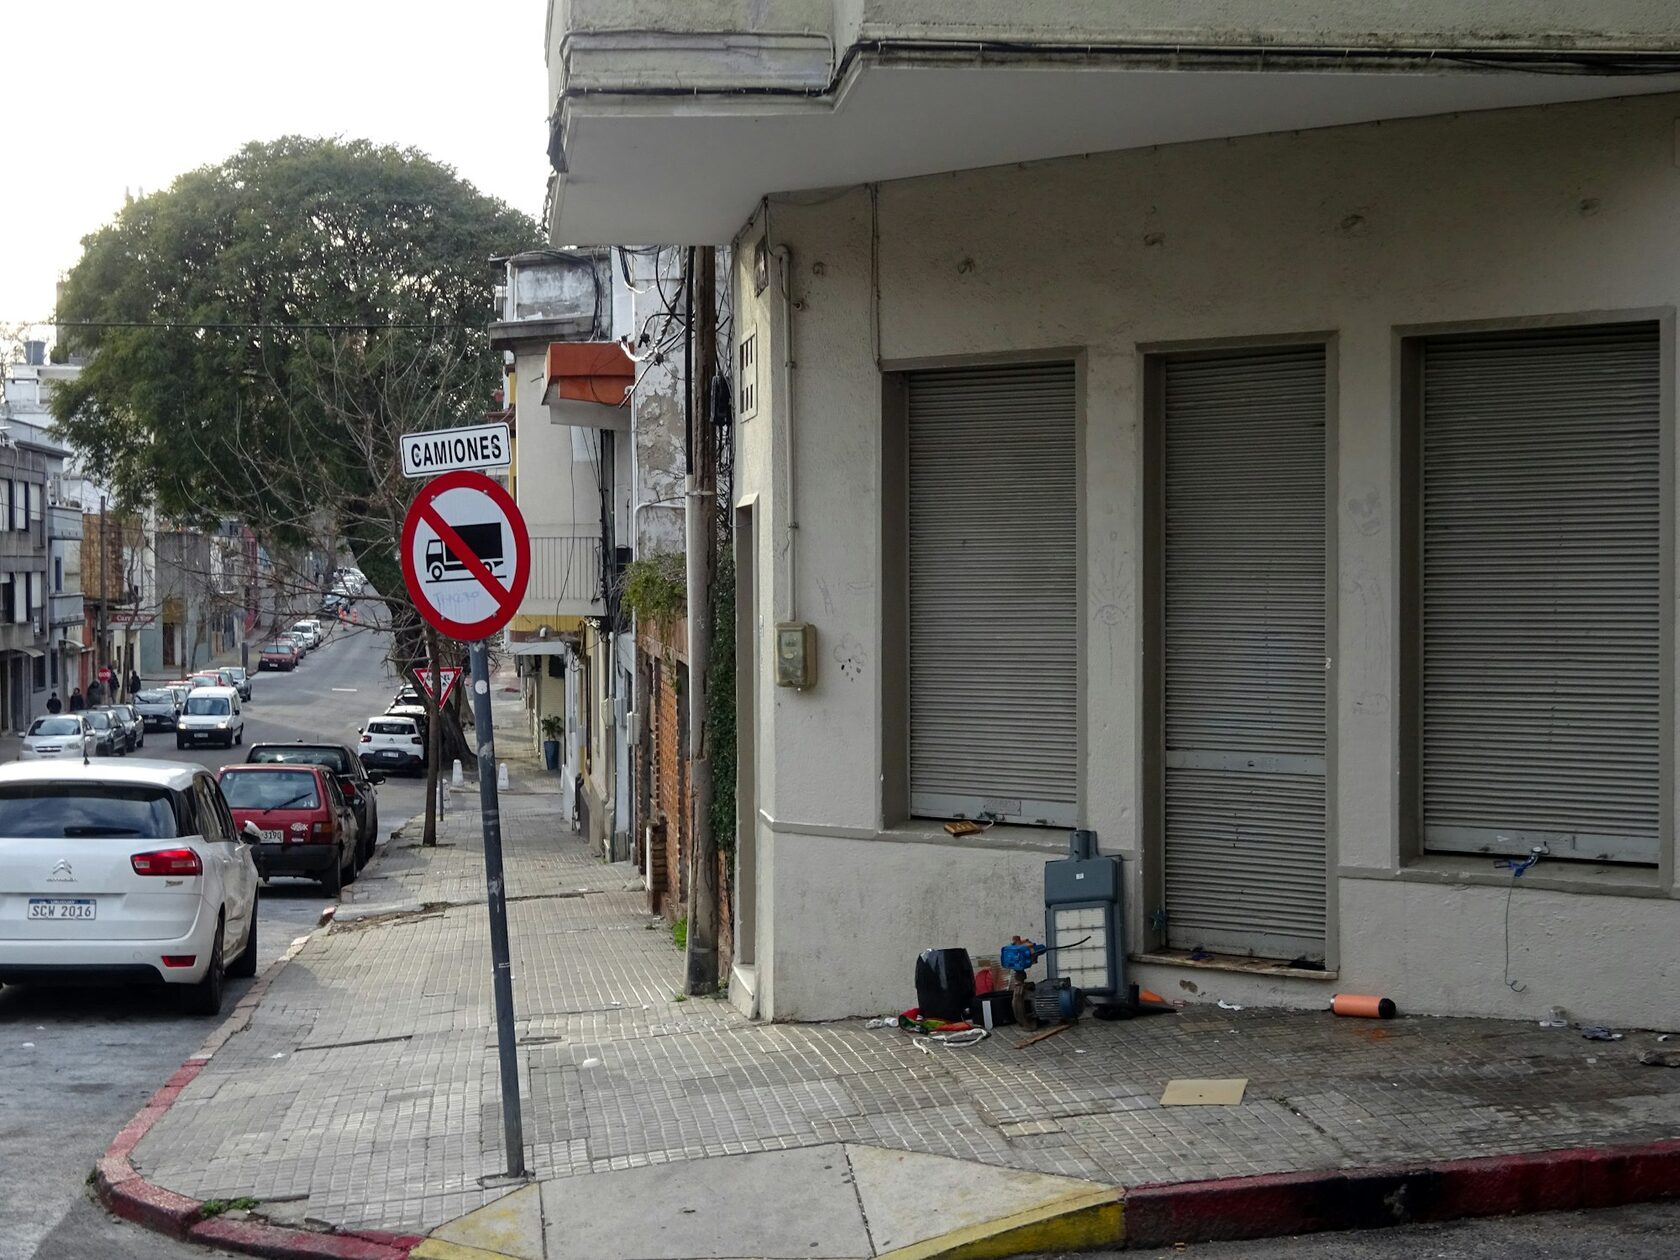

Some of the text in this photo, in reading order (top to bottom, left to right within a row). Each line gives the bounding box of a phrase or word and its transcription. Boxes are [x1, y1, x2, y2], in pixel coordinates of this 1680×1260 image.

[411, 434, 502, 467] CAMIONES
[32, 905, 91, 917] SCW 2016
